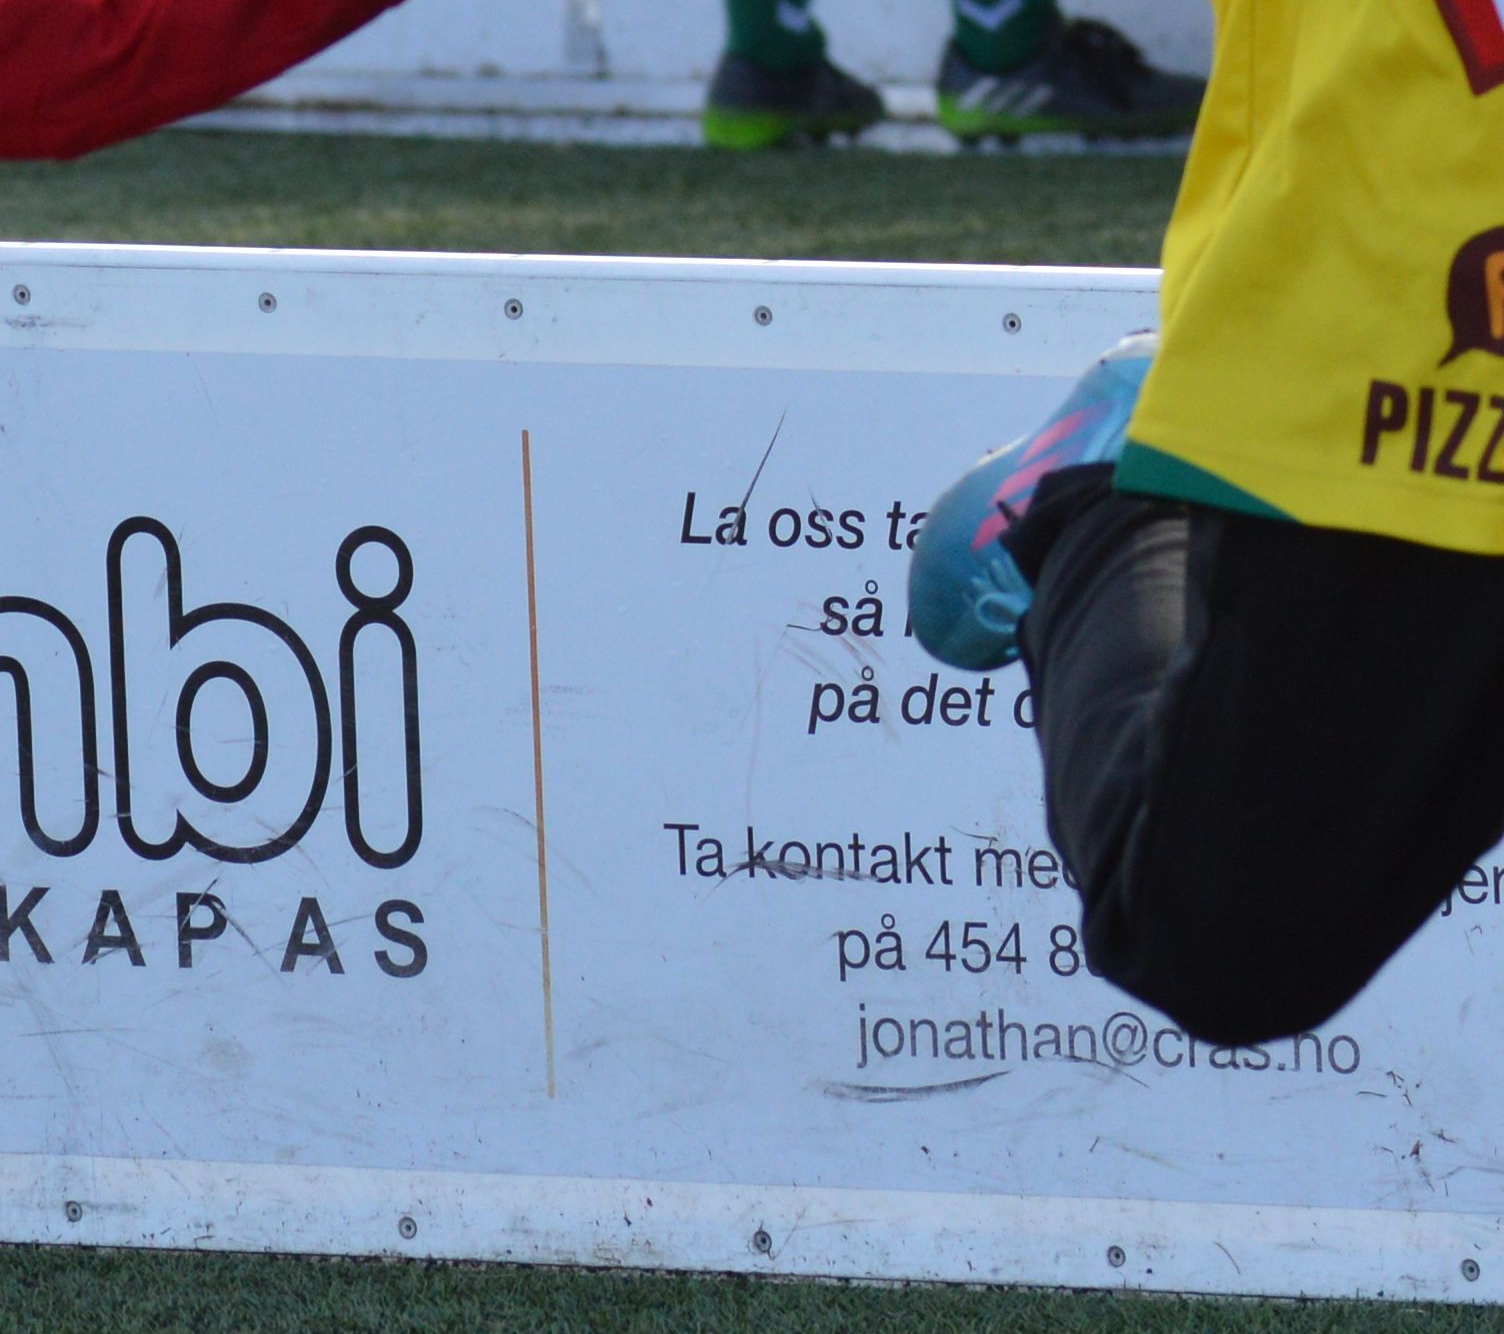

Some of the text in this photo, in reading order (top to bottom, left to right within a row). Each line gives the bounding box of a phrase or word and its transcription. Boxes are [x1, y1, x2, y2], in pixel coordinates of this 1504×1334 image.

[680, 491, 748, 546] La
[768, 503, 865, 550] oss
[819, 579, 885, 638] så
[807, 665, 881, 734] på
[901, 673, 995, 728] det
[663, 823, 728, 878] Ta
[747, 826, 953, 887] kontakt
[279, 895, 429, 979] AS
[837, 913, 906, 981] på
[925, 920, 1027, 976] 454
